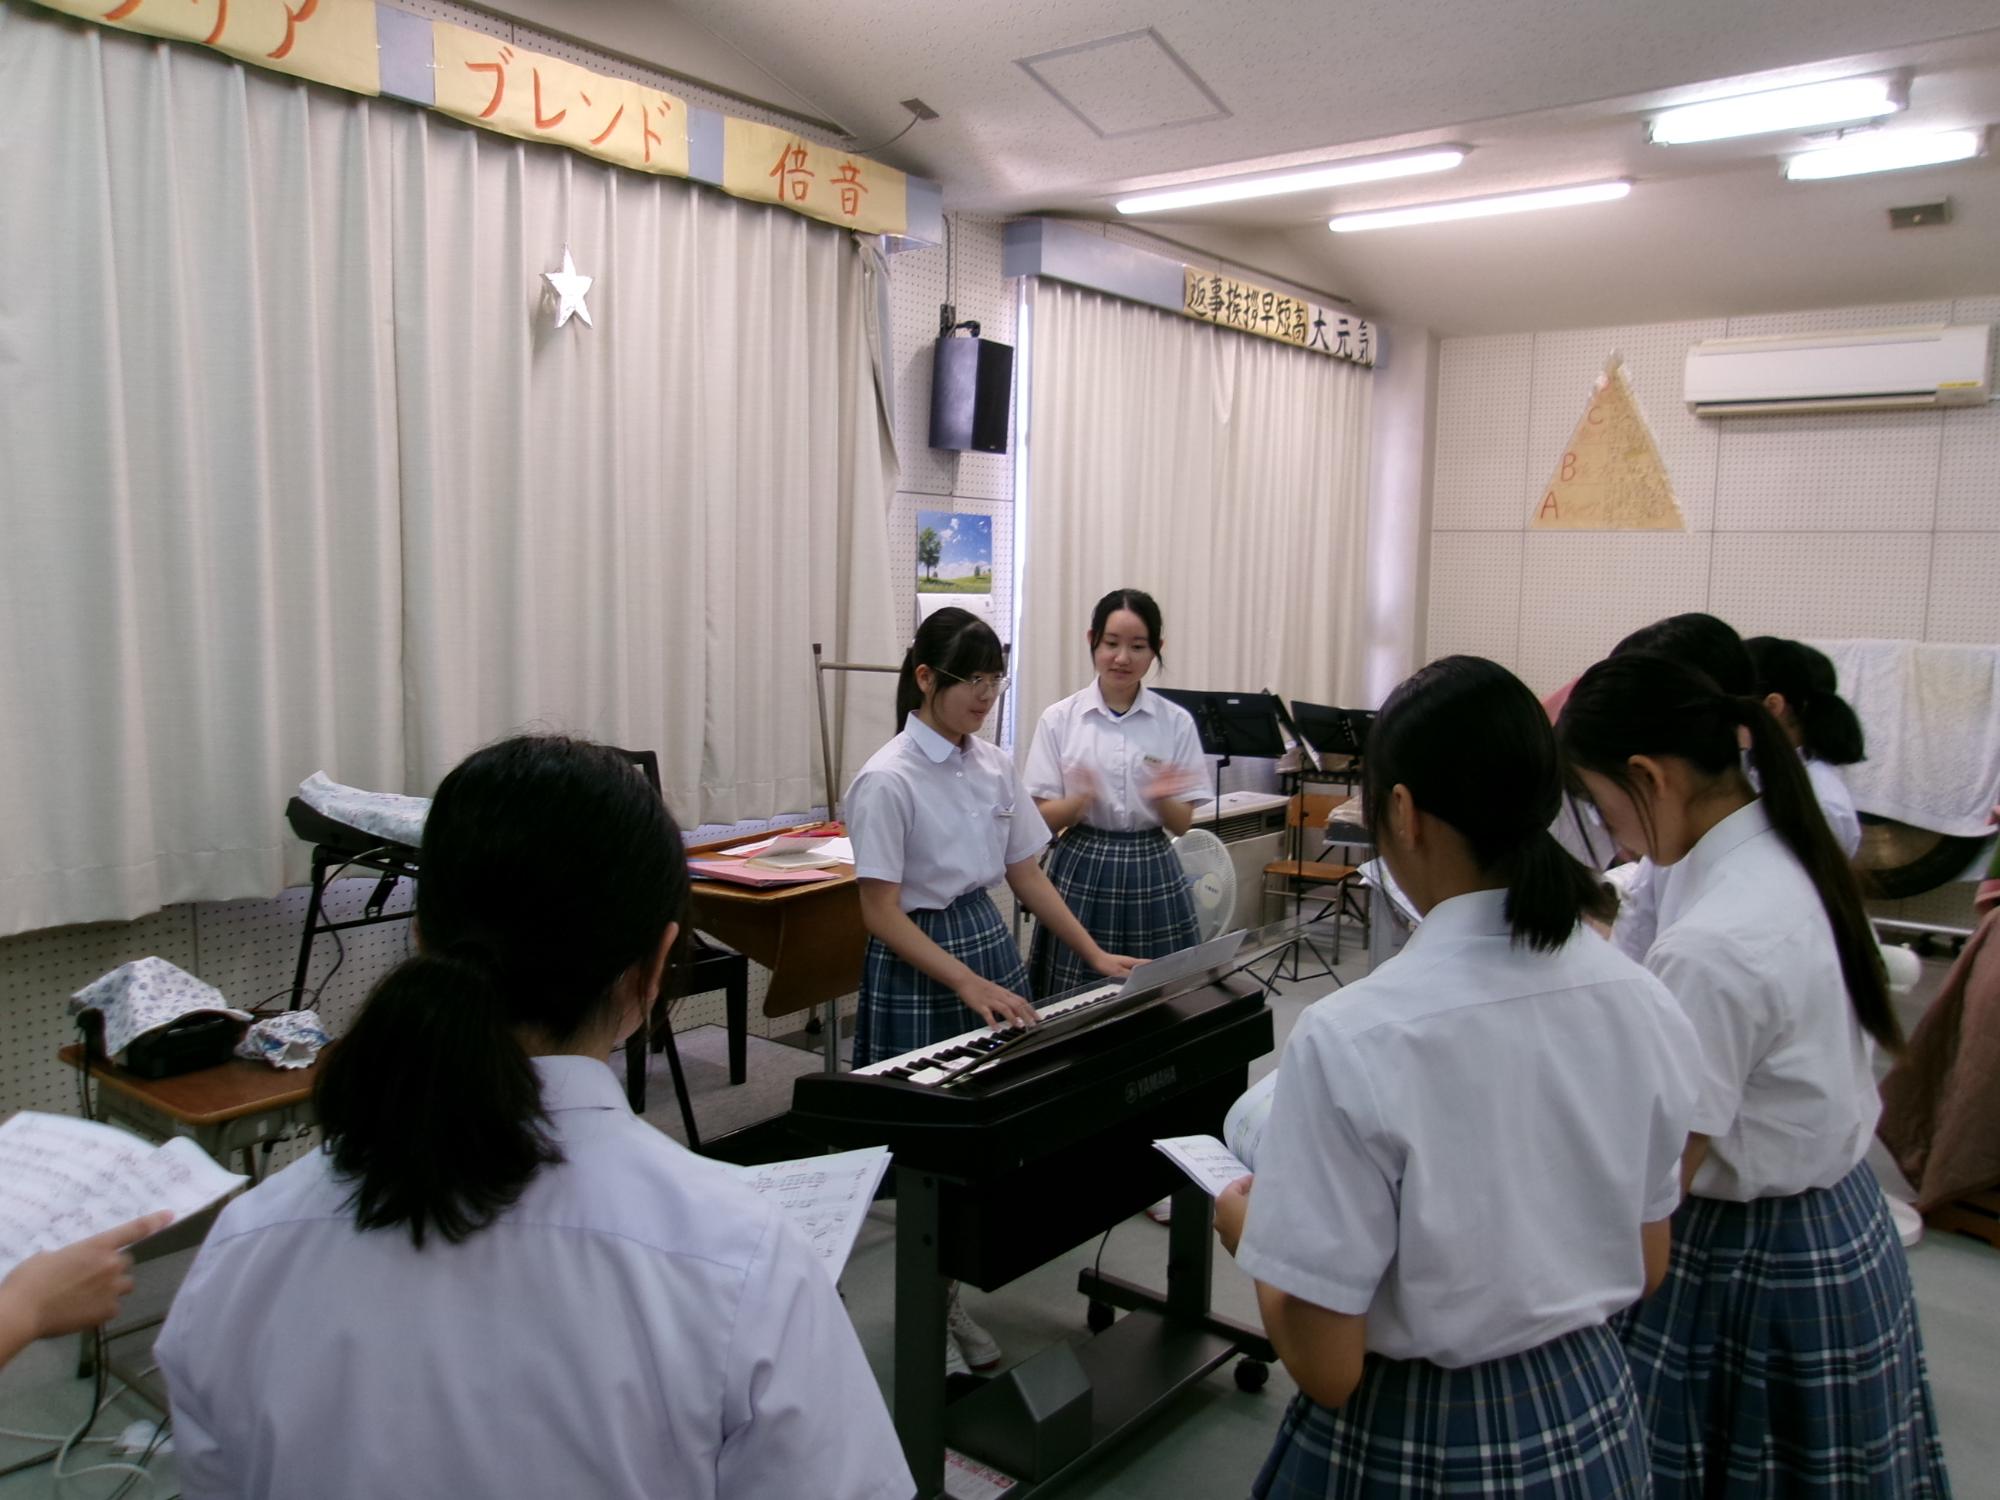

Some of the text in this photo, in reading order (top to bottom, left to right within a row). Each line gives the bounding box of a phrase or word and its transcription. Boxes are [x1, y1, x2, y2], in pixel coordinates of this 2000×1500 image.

[464, 46, 672, 163] ブレンド
[770, 143, 869, 216] 倍音
[1308, 306, 1374, 369] 大元気
[1587, 406, 1604, 425] C
[1561, 452, 1577, 482] B
[1540, 491, 1559, 520] A
